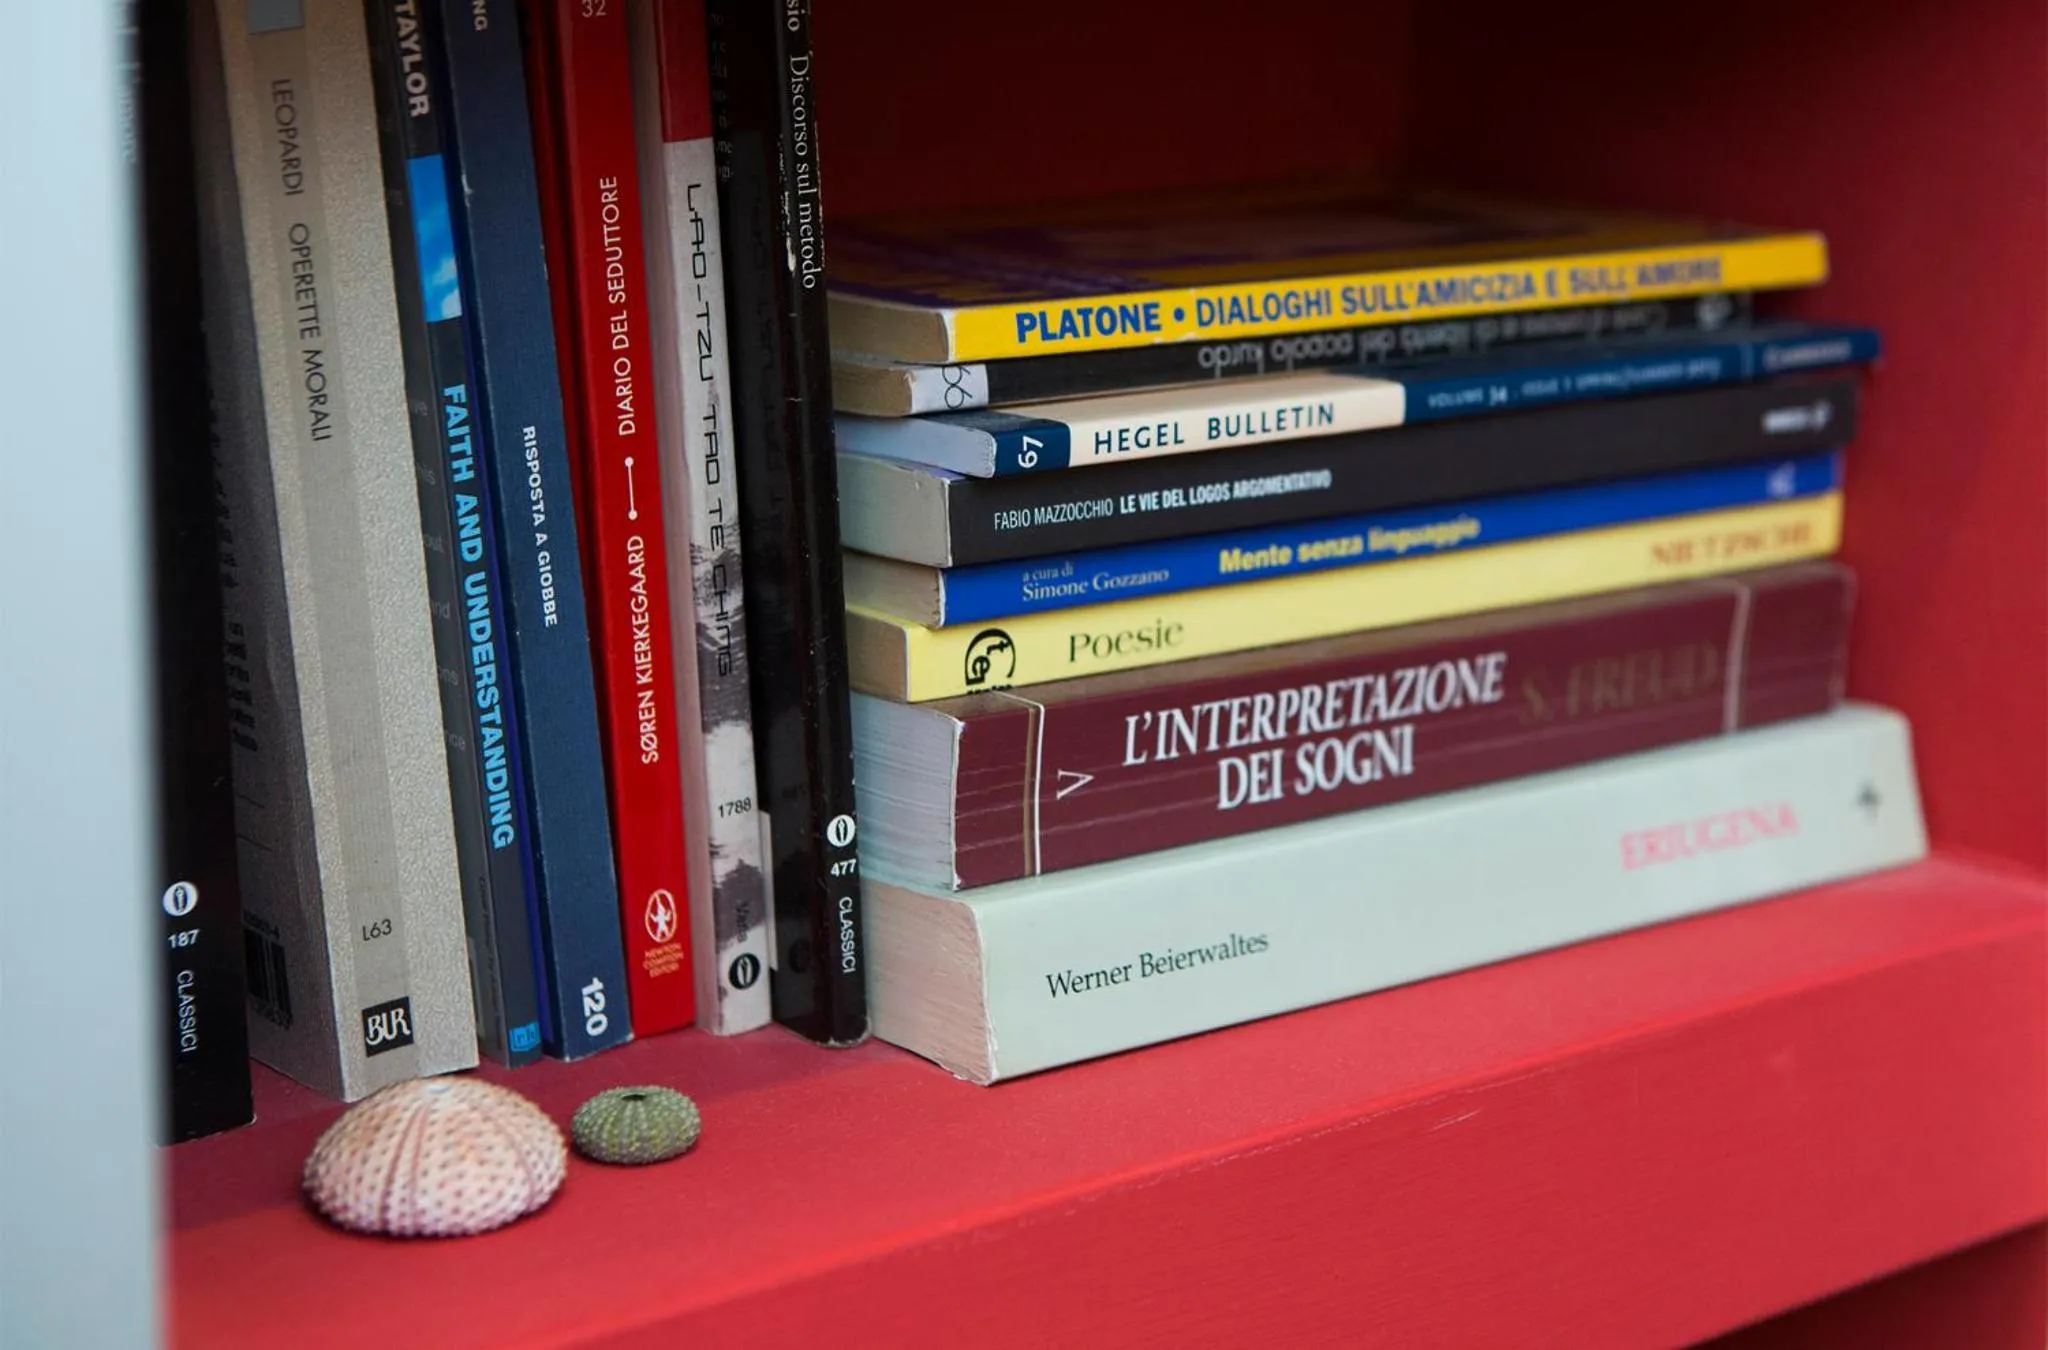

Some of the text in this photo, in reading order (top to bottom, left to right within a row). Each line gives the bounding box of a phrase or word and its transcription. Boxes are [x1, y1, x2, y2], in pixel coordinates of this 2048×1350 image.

[581, 0, 607, 18] 32
[394, 0, 430, 118] TAYLOR
[789, 54, 824, 290] Discorso sul metodo
[271, 78, 333, 442] LEOPARDI OPERETTE MORALI
[687, 183, 714, 381] LAO-TZU
[600, 176, 636, 436] DIARIO DEL SEDUTTORE
[1016, 302, 1161, 343] PLATONE
[1196, 288, 1332, 328] DIALOGHI
[1342, 270, 1536, 316] SULL'AMICIZIA
[1545, 268, 1560, 298] E
[444, 384, 476, 484] FAITH
[1018, 435, 1044, 469] 67
[1094, 402, 1336, 454] HEGEL BULLETIN
[454, 494, 484, 563] AND
[522, 426, 558, 628] RISPOSTA A GIOBBE
[994, 469, 1332, 531] FABIO MAZZOCCHIO LE VIE DEL LOGOS ARGOMENTATIVO
[703, 404, 733, 677] TAO TE CHING
[1022, 561, 1075, 581] a cura di
[1219, 513, 1482, 574] Mente senza linguaggio
[1022, 567, 1170, 601] Simone Gozzano
[626, 535, 661, 764] SØREN KIERKEGAARD
[1068, 617, 1184, 664] Poesie
[464, 572, 515, 849] UNDERSTANDING
[1122, 652, 1508, 768] L'INTERPRETAZIONE
[1217, 724, 1415, 811] DEI SOGNI
[718, 797, 753, 817] 1788
[1618, 799, 1803, 873] ERIUGENA
[830, 857, 857, 877] 477
[168, 929, 201, 949] 187
[362, 918, 393, 942] L63
[838, 896, 857, 974] CLASSICI
[1046, 932, 1270, 999] Werner Beierwaltes
[176, 969, 198, 1053] CLASSICI
[365, 1006, 411, 1047] BUR
[580, 976, 609, 1037] 120
